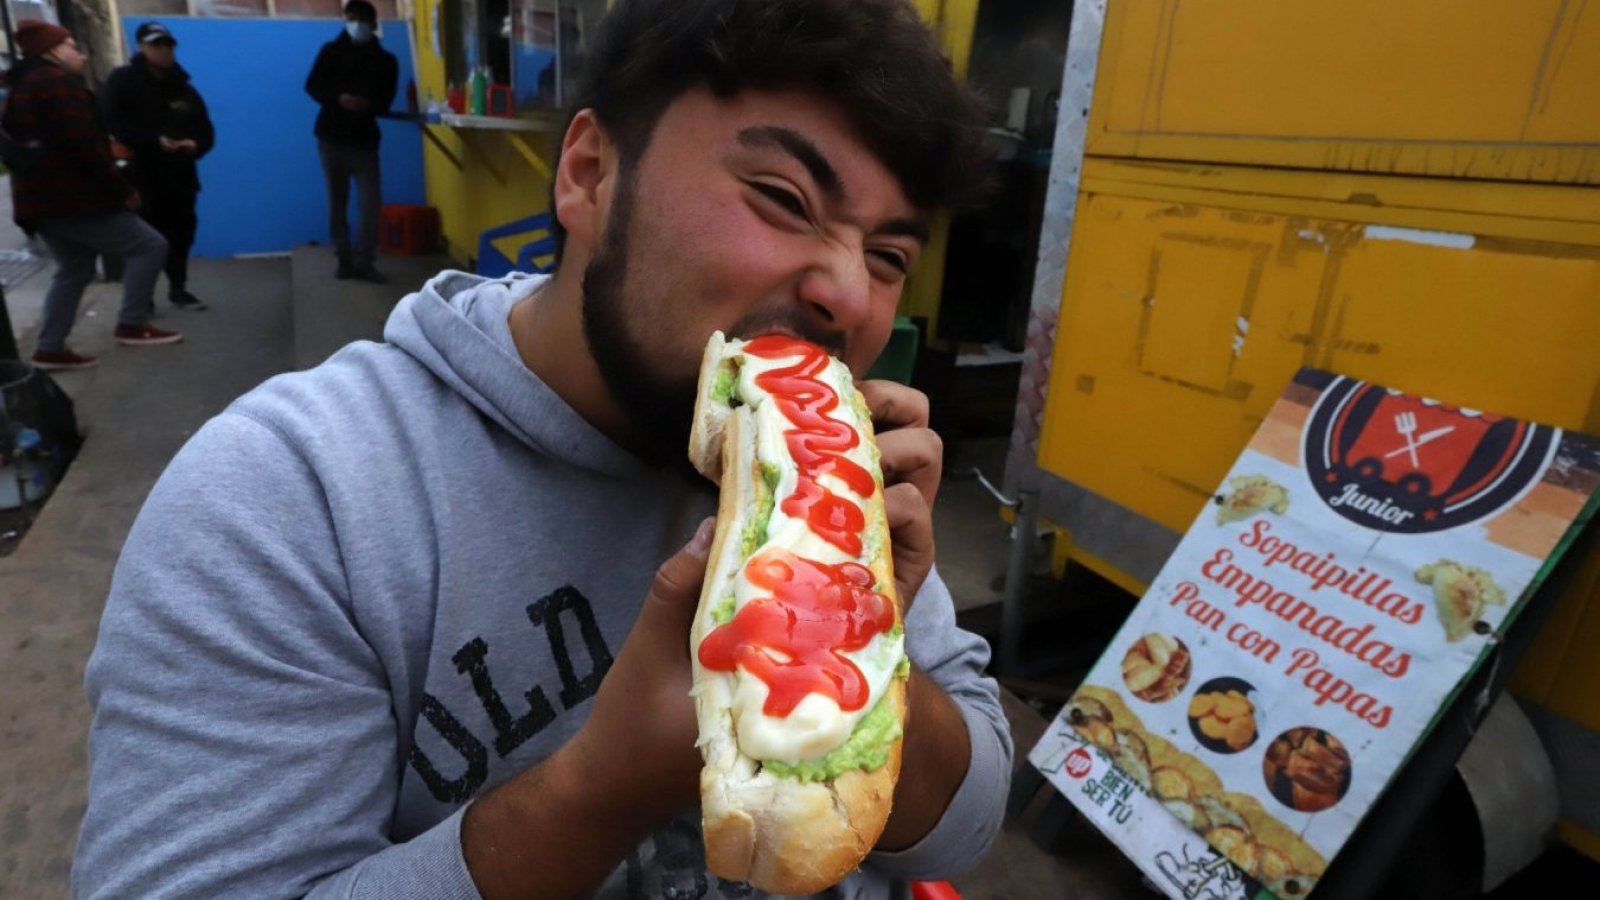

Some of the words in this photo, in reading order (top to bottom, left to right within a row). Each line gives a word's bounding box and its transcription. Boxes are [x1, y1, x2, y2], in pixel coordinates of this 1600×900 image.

[1329, 482, 1415, 525] Junior
[1201, 548, 1412, 679] Empanadas
[1238, 519, 1425, 625] Sopaipillas
[409, 585, 613, 804] OLD
[1169, 580, 1226, 632] Pan
[1226, 622, 1281, 665] con
[1284, 648, 1393, 729] Papas
[1081, 777, 1112, 808] SER
[1100, 767, 1134, 802] BIEN
